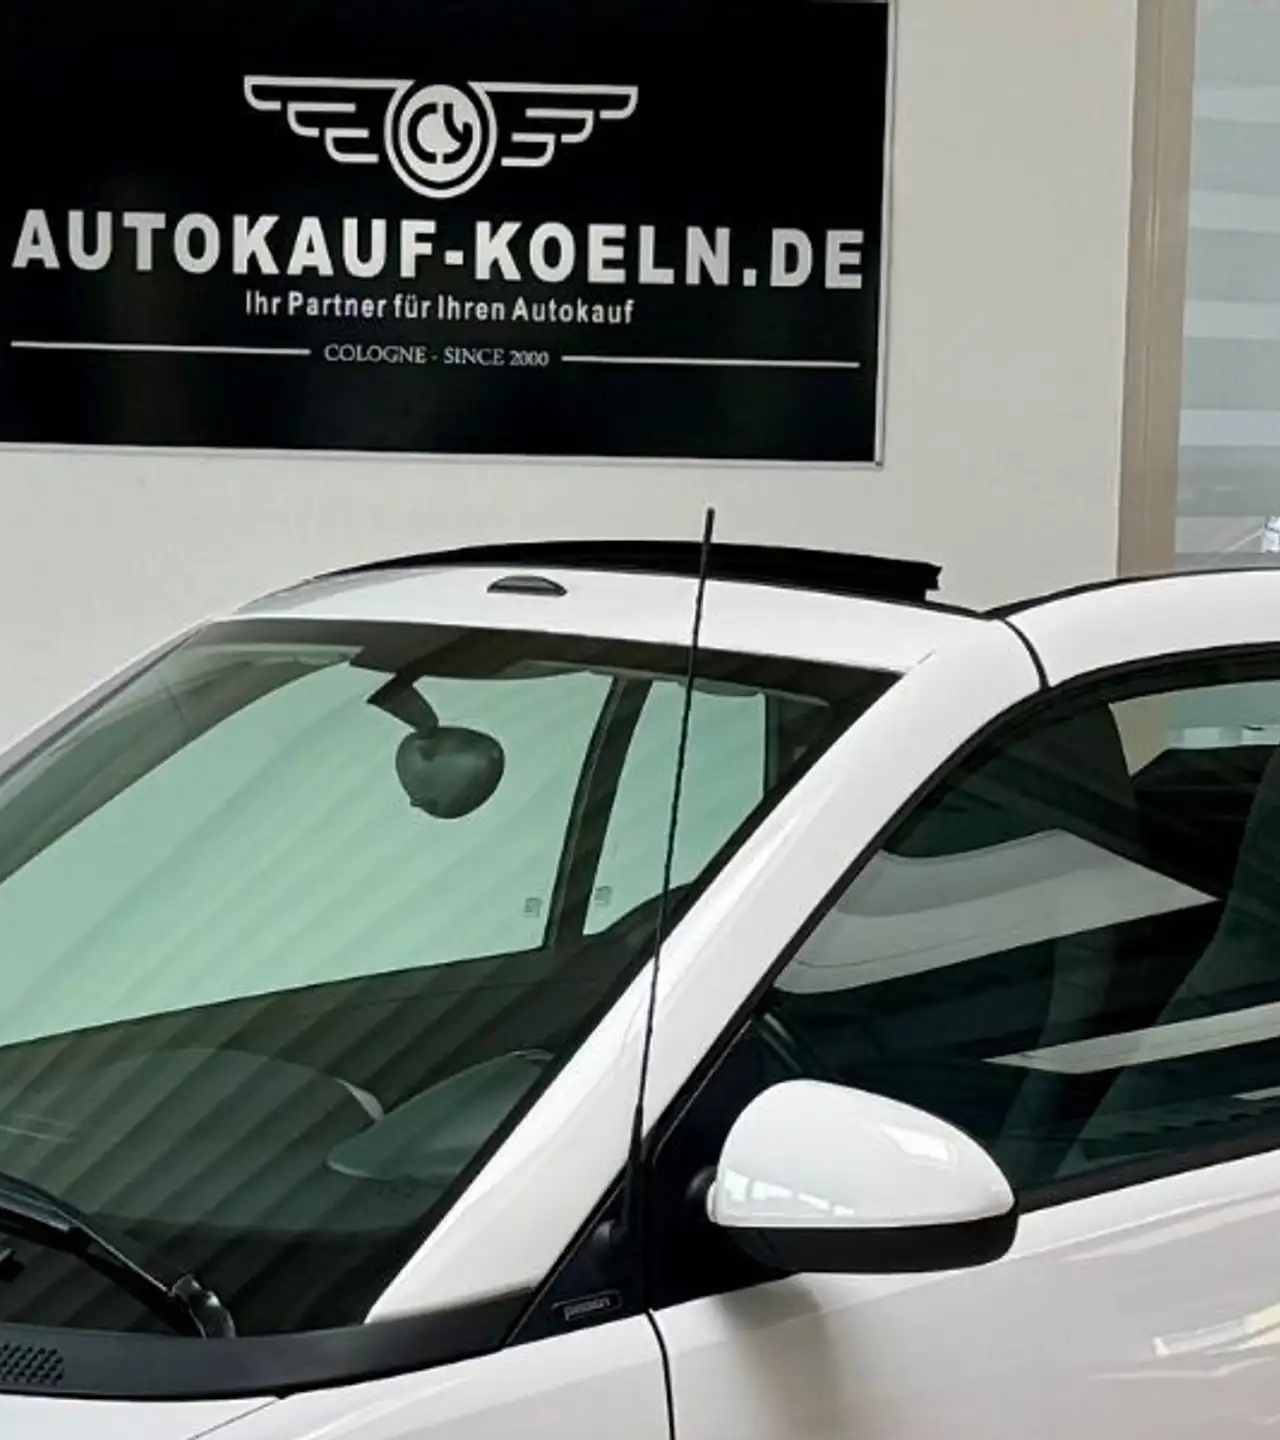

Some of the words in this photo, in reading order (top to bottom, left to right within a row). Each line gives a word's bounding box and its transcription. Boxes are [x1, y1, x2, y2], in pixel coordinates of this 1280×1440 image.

[11, 209, 865, 289] AUTOKAUF-KOELN.DE
[246, 290, 282, 315] Ihr
[288, 290, 388, 318] Partner
[393, 293, 432, 319] für
[437, 294, 505, 321] Ihren
[511, 296, 635, 324] Autokauf
[324, 344, 427, 364] COLOGNE
[443, 347, 505, 366] SINCE
[509, 350, 550, 366] 2000
